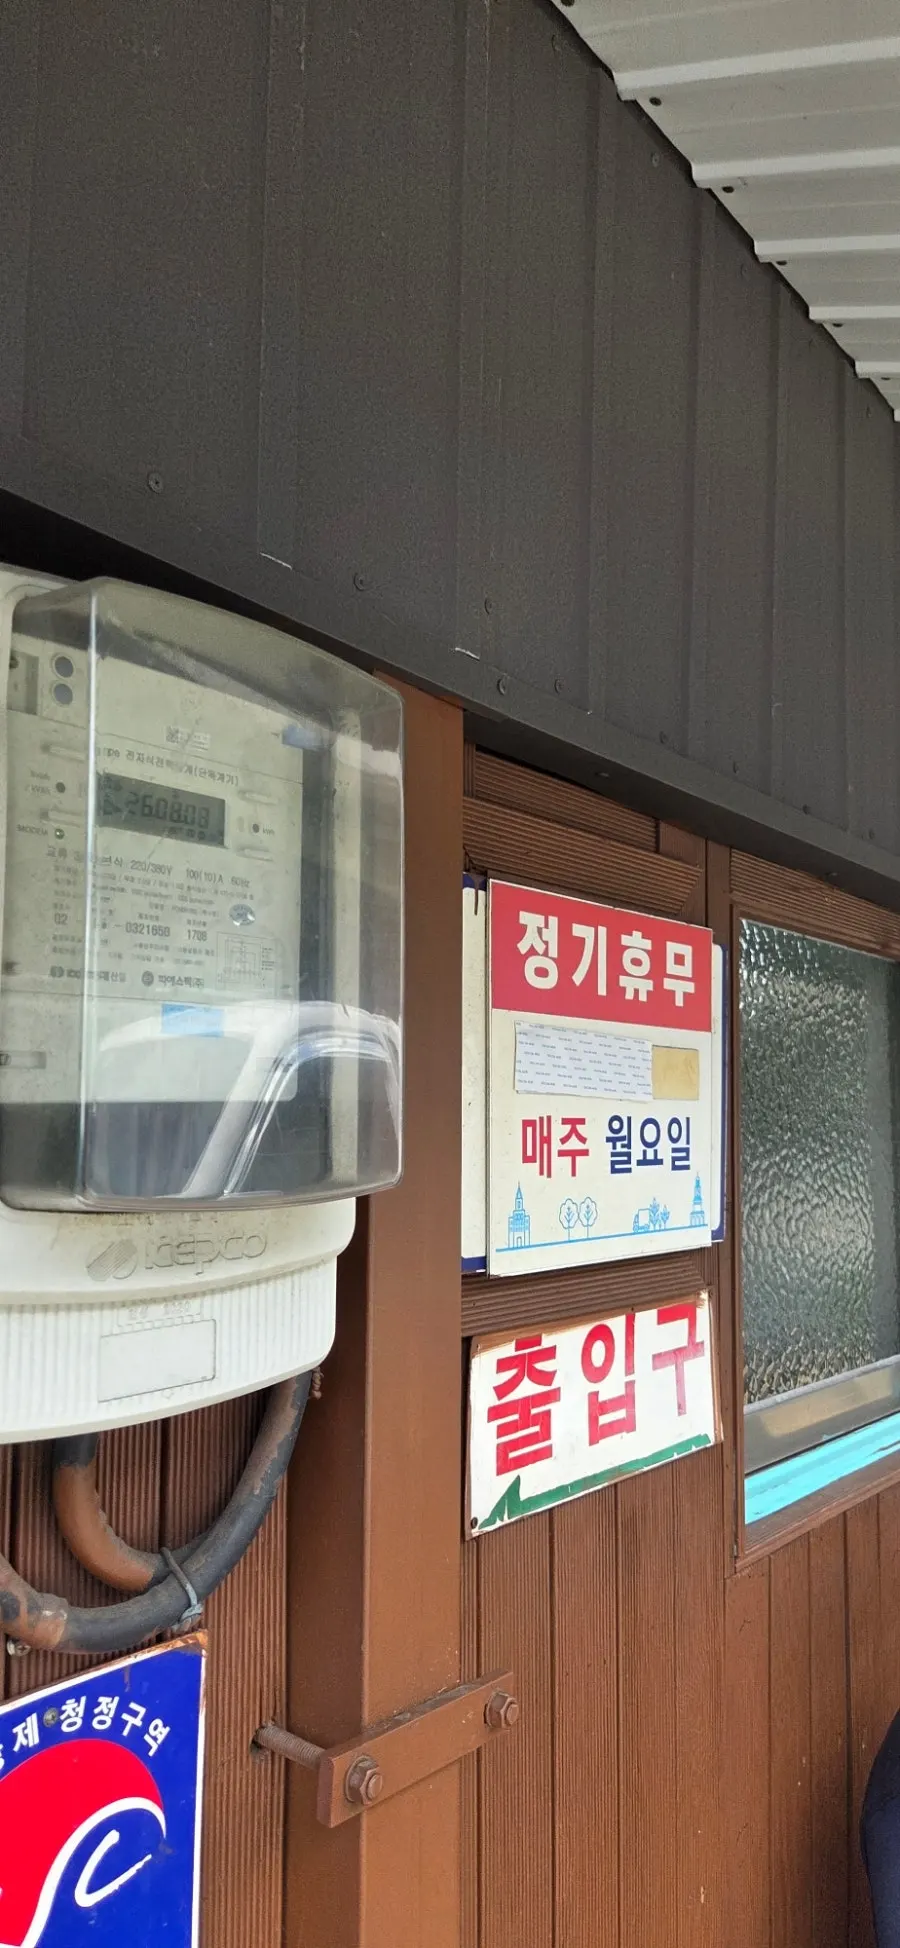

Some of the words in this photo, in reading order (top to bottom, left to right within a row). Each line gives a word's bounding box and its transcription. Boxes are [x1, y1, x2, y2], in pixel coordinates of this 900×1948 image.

[517, 911, 695, 1007] 정기휴무
[521, 1115, 590, 1178] 매주
[605, 1114, 691, 1175] 월요일
[487, 1303, 705, 1476] 출입구
[59, 1696, 171, 1757] 청정구역
